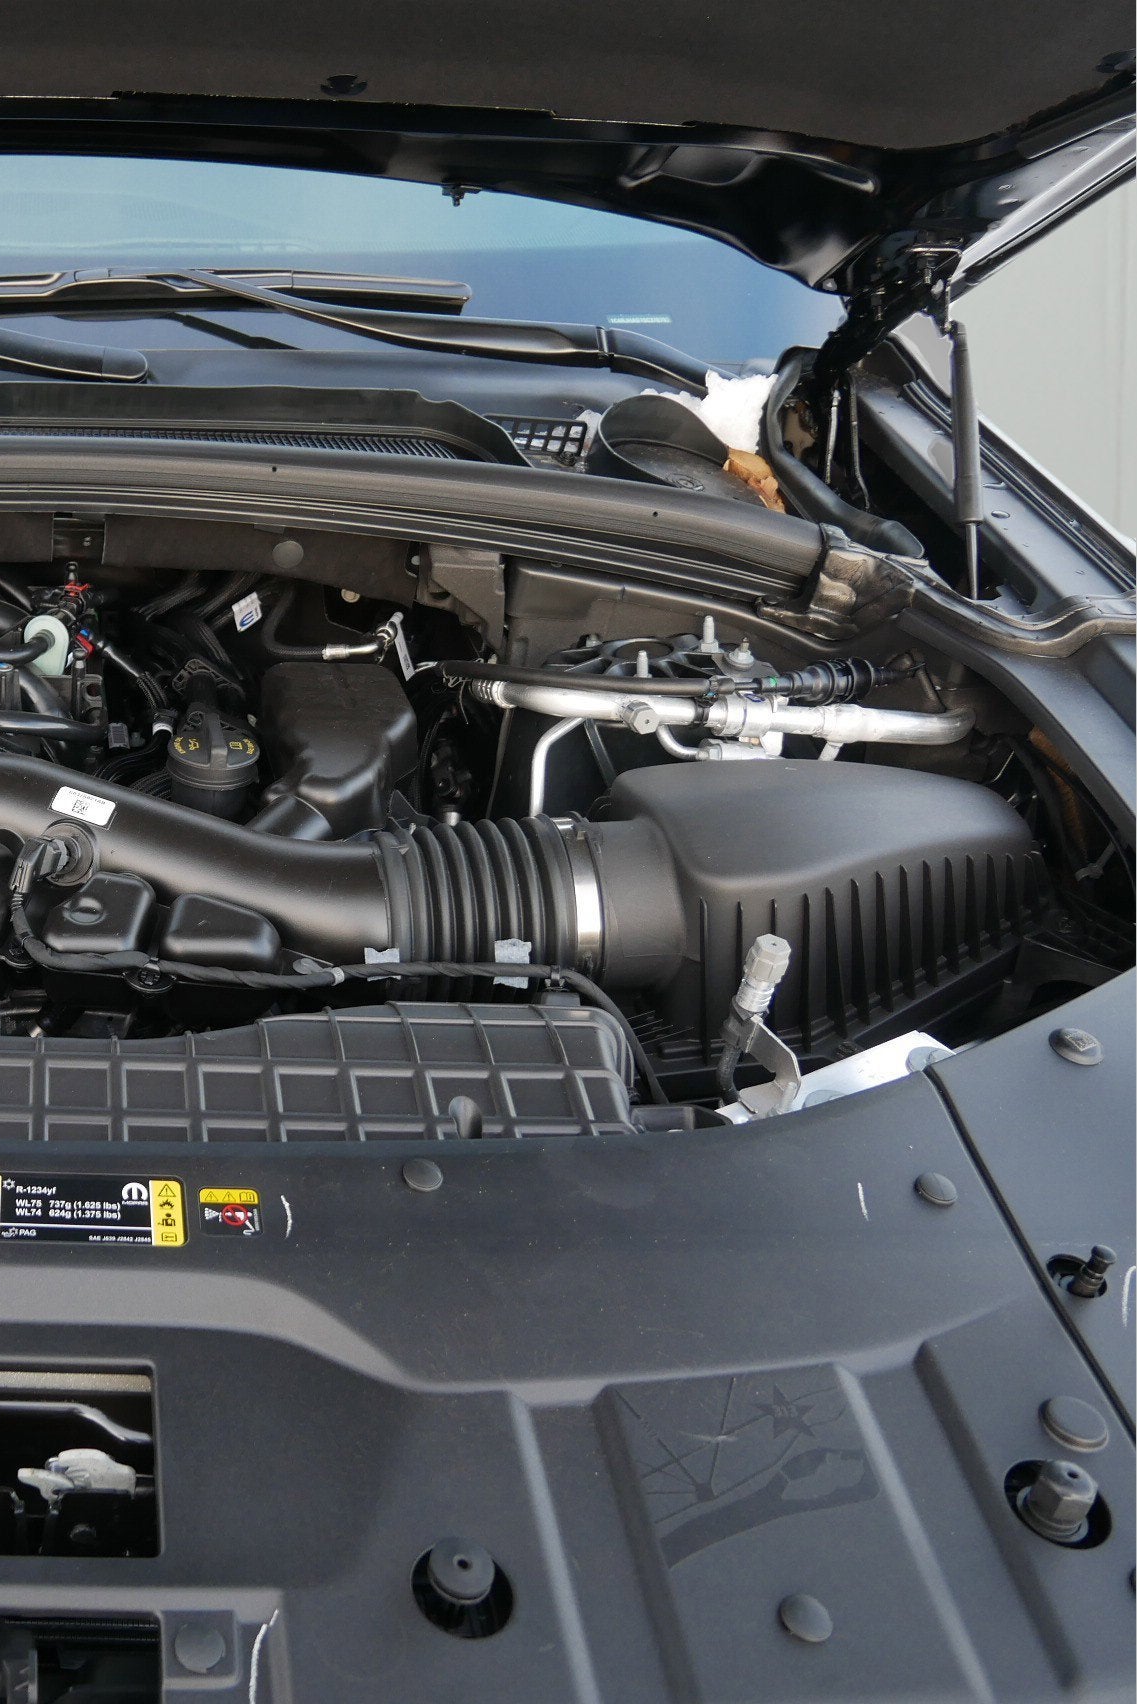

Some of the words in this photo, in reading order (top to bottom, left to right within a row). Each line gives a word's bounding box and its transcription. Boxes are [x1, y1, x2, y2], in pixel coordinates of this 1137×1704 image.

[15, 1186, 57, 1196] R-1234yf
[15, 1199, 43, 1208] WL75
[48, 1200, 71, 1211] 737g
[73, 1201, 102, 1210] (1.625
[103, 1202, 121, 1211] lbs)
[15, 1208, 43, 1217] WL74
[48, 1208, 71, 1219] 624g
[73, 1210, 102, 1219] (1.375
[103, 1210, 121, 1220] lbs)
[19, 1229, 37, 1237] PAG
